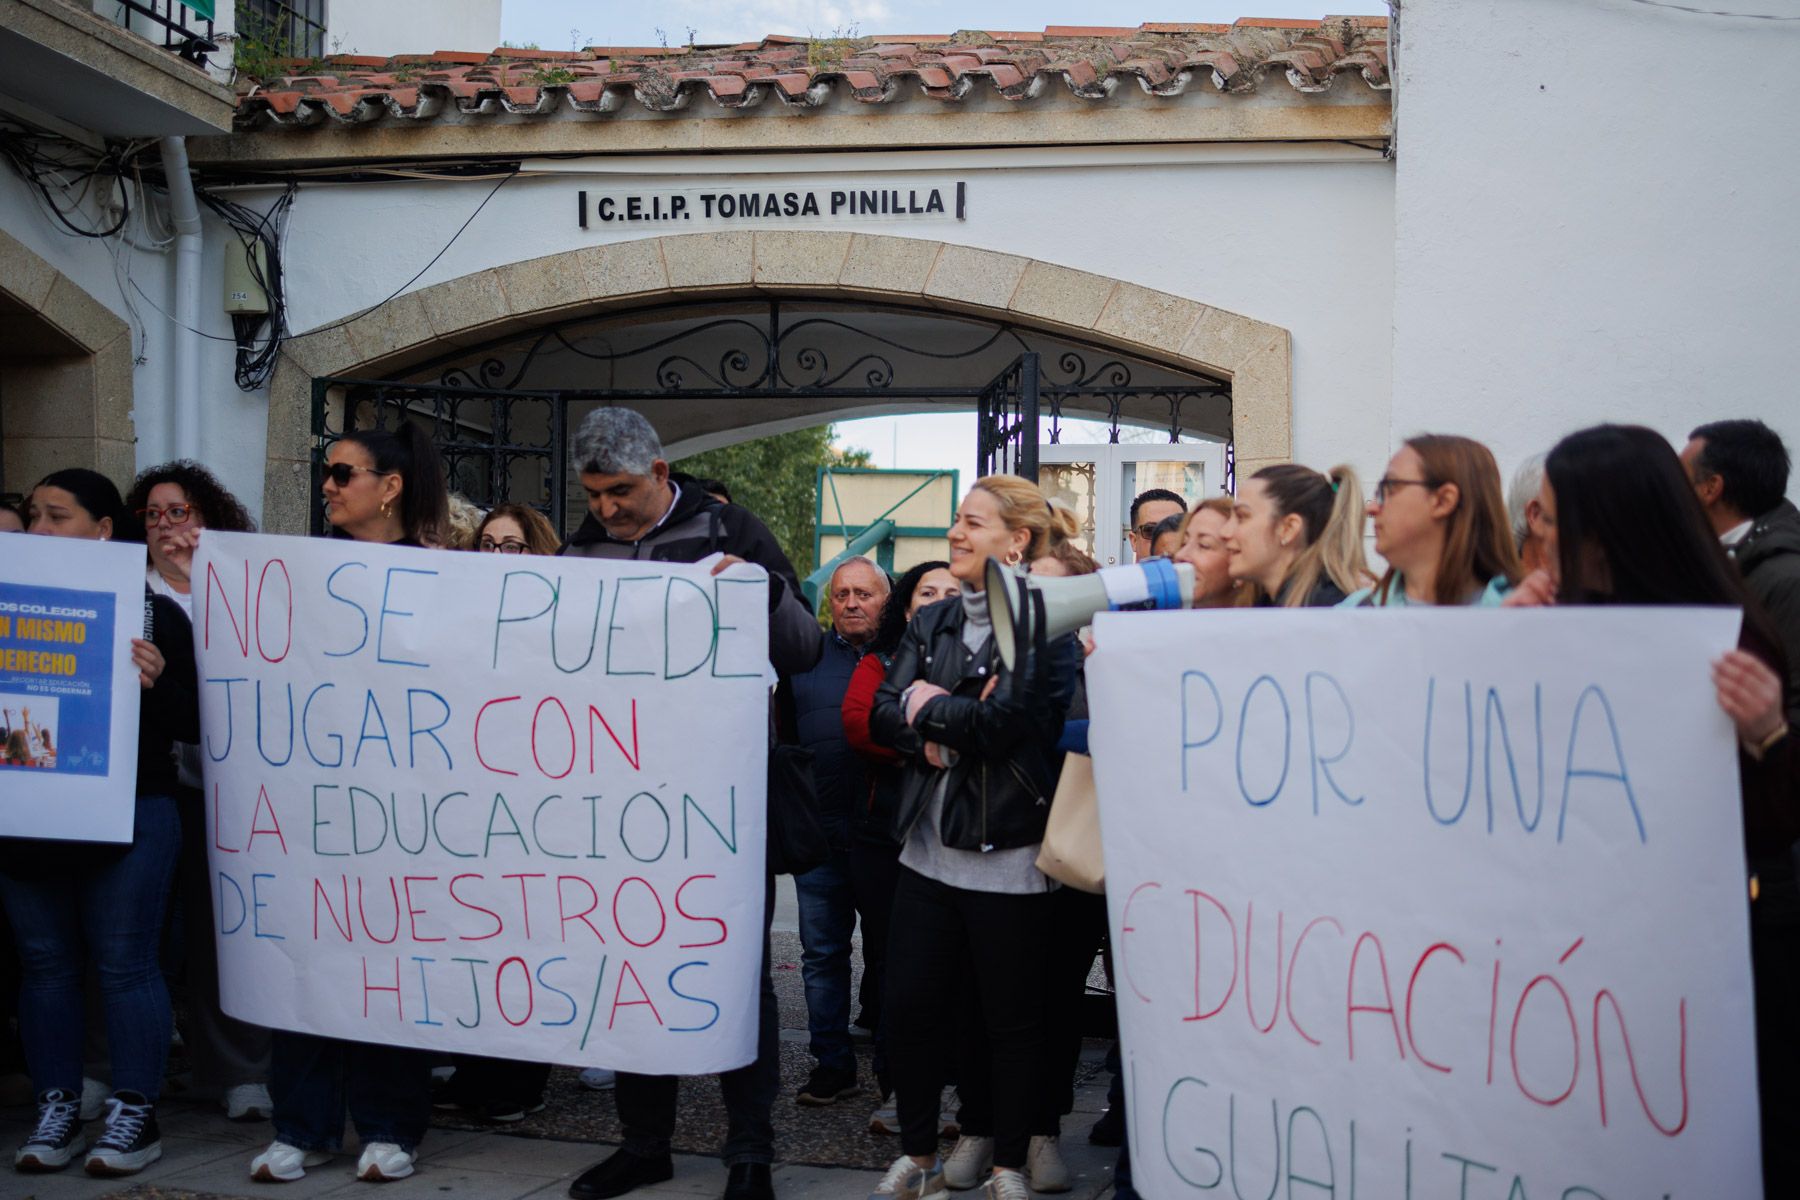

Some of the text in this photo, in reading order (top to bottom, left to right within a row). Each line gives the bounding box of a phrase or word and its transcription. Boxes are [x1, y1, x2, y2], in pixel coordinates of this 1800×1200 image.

[599, 189, 945, 221] C.E.I.P. TOMASA PINILLA
[16, 617, 87, 644] MISMO
[19, 604, 98, 619] COLEGIOS
[205, 559, 767, 680] NO SE PUEDE
[206, 677, 640, 779] JUGAR CON
[1181, 669, 1647, 844] POR UNA
[215, 783, 738, 862] LA EDUCACIÓN
[218, 872, 728, 948] DE NUESTROS
[362, 955, 720, 1051] HIJOS/AS
